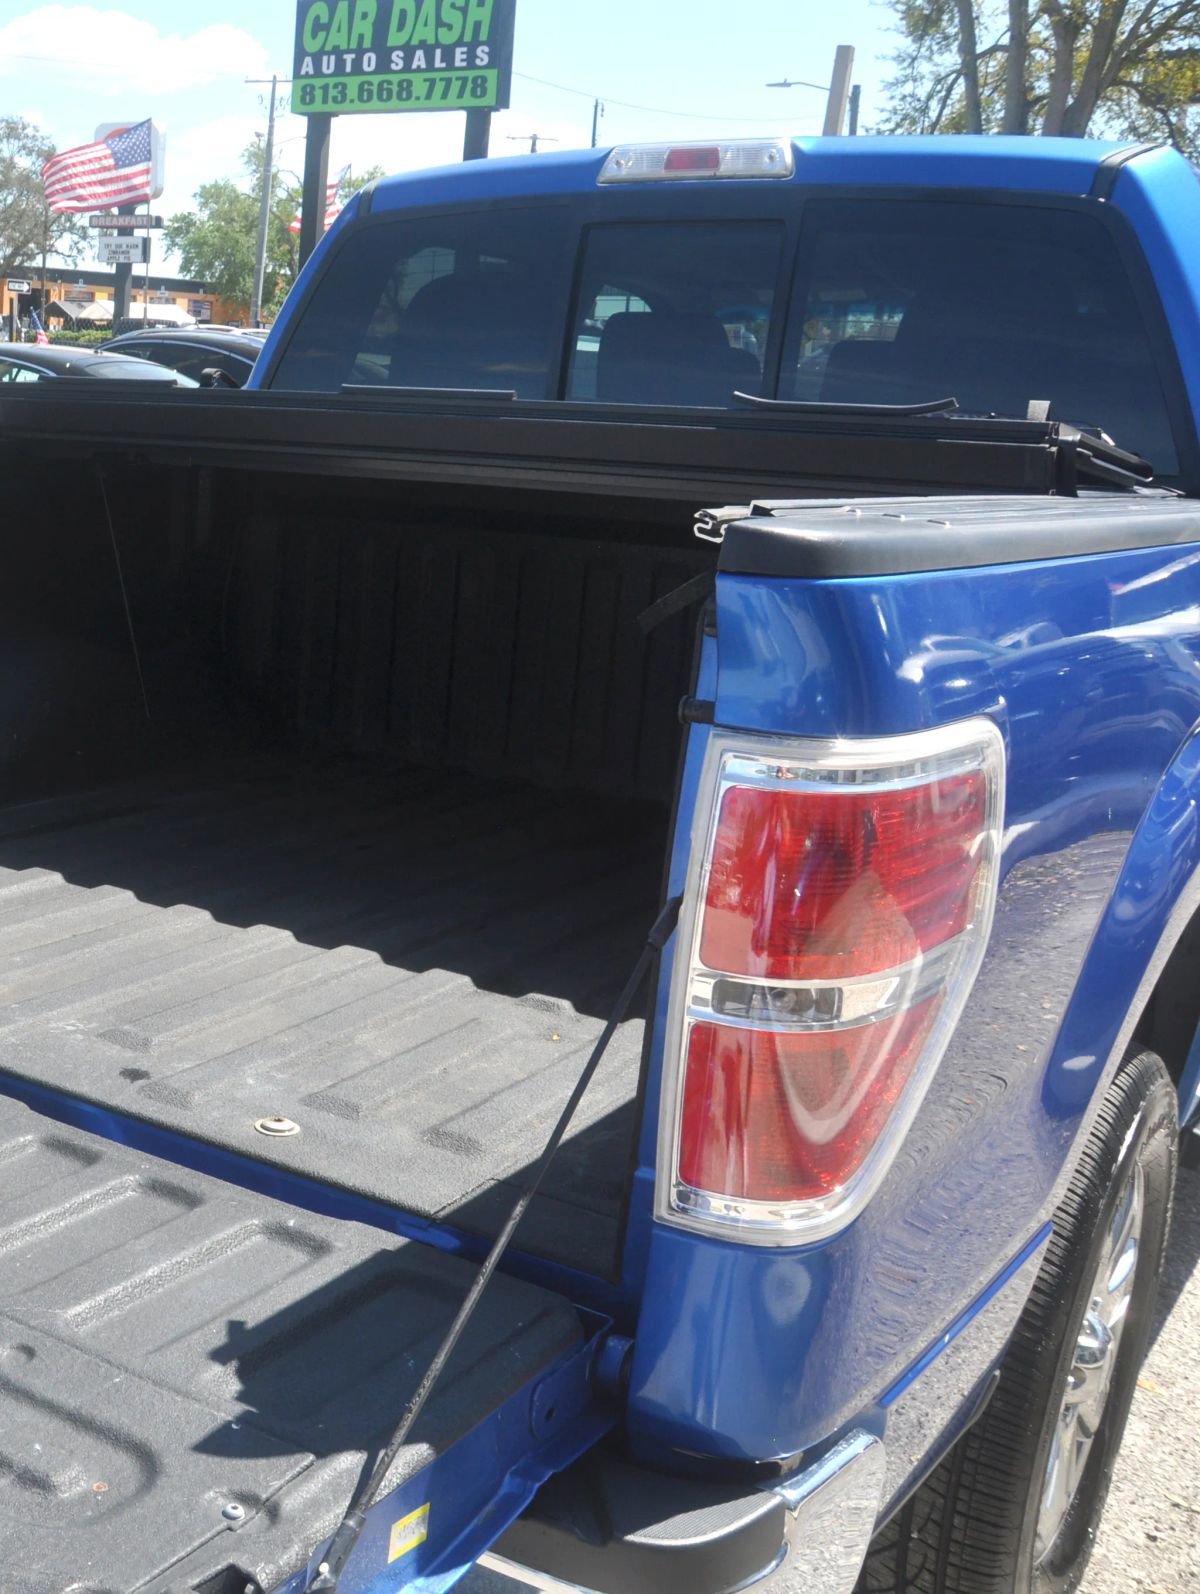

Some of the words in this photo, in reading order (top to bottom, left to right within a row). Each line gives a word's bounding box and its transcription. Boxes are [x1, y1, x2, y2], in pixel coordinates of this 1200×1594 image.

[302, 1, 378, 53] CAR
[387, 0, 494, 47] DASH
[300, 52, 377, 76] AUTO
[390, 45, 490, 71] SALES
[300, 74, 489, 107] 813.668.7778
